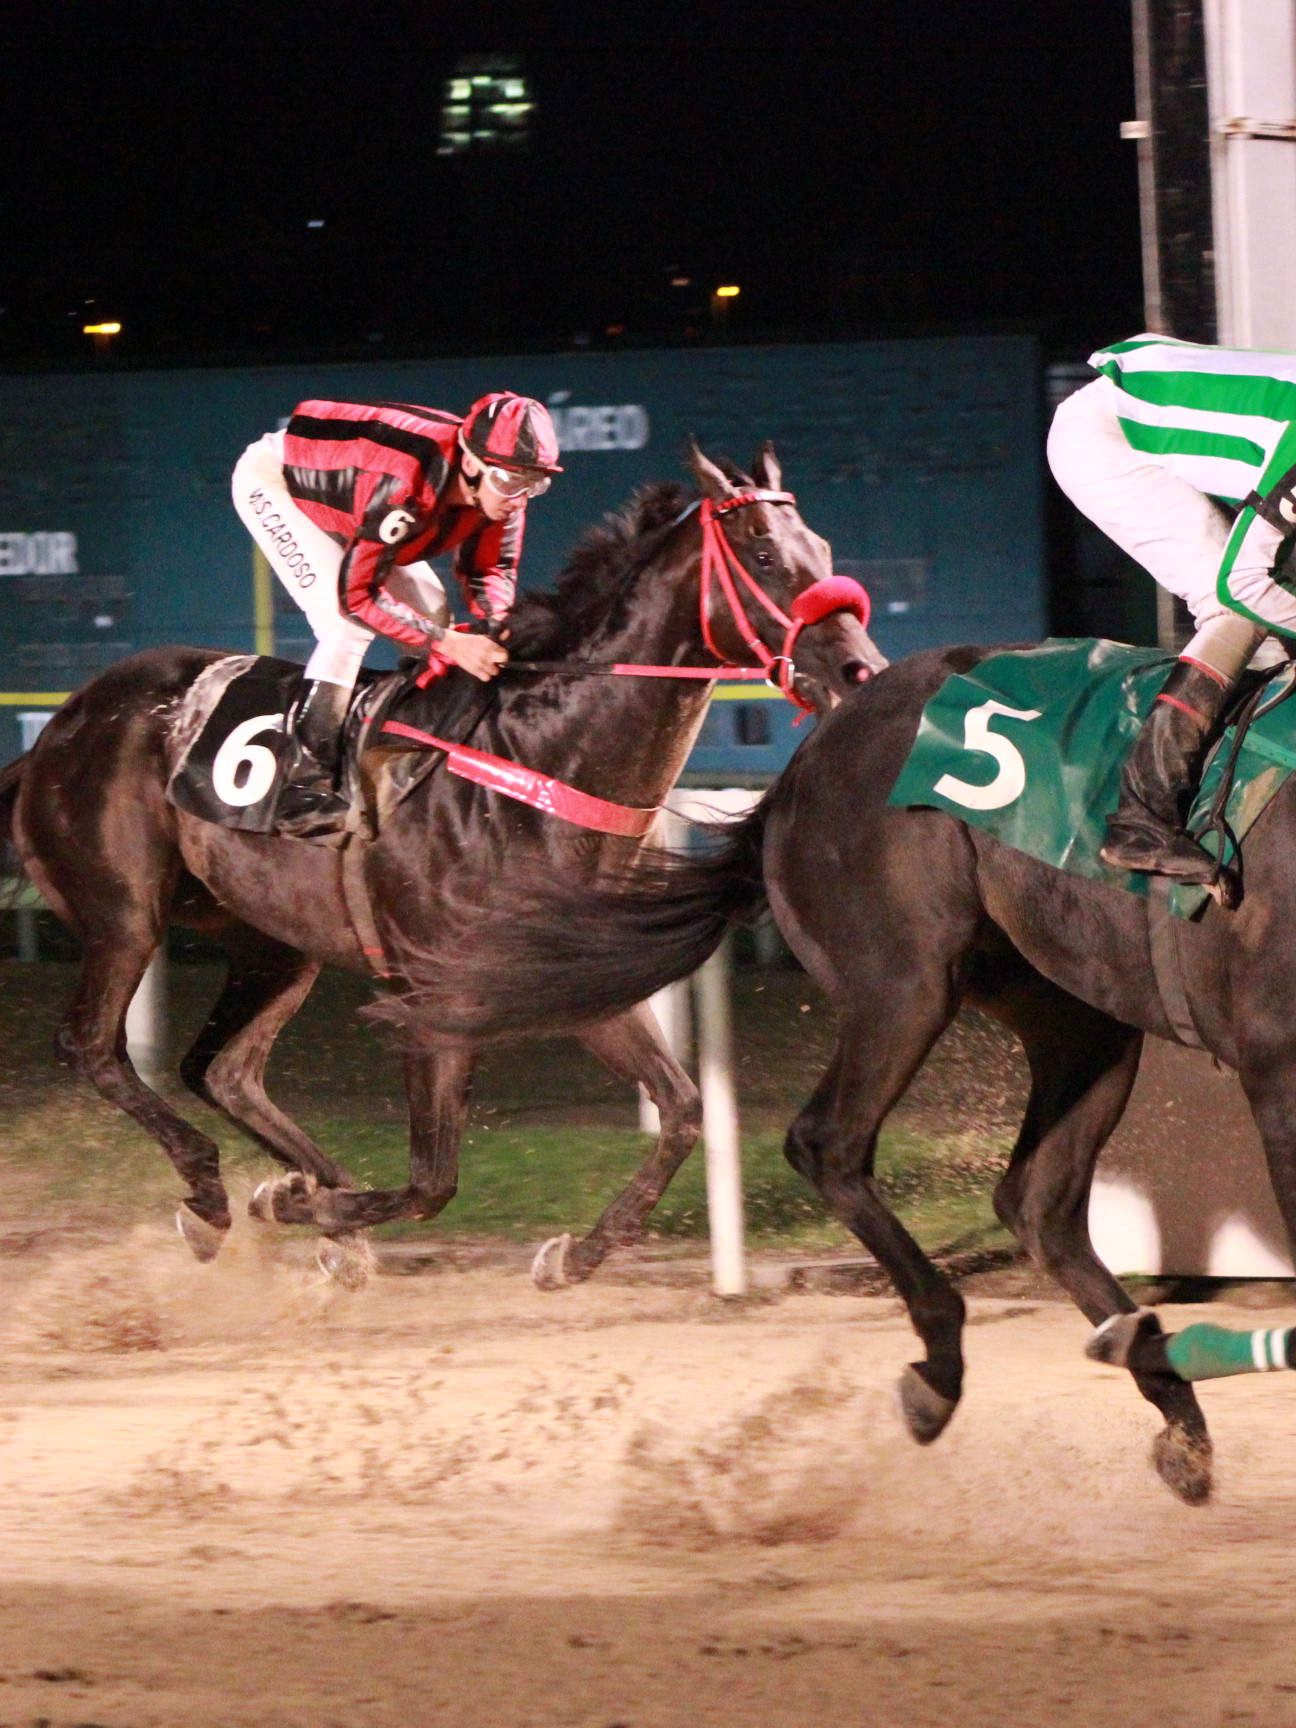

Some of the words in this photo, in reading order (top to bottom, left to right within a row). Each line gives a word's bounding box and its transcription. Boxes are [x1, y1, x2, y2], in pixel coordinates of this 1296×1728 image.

[378, 509, 416, 545] 6
[212, 713, 285, 807] 6
[933, 699, 1043, 810] 5
